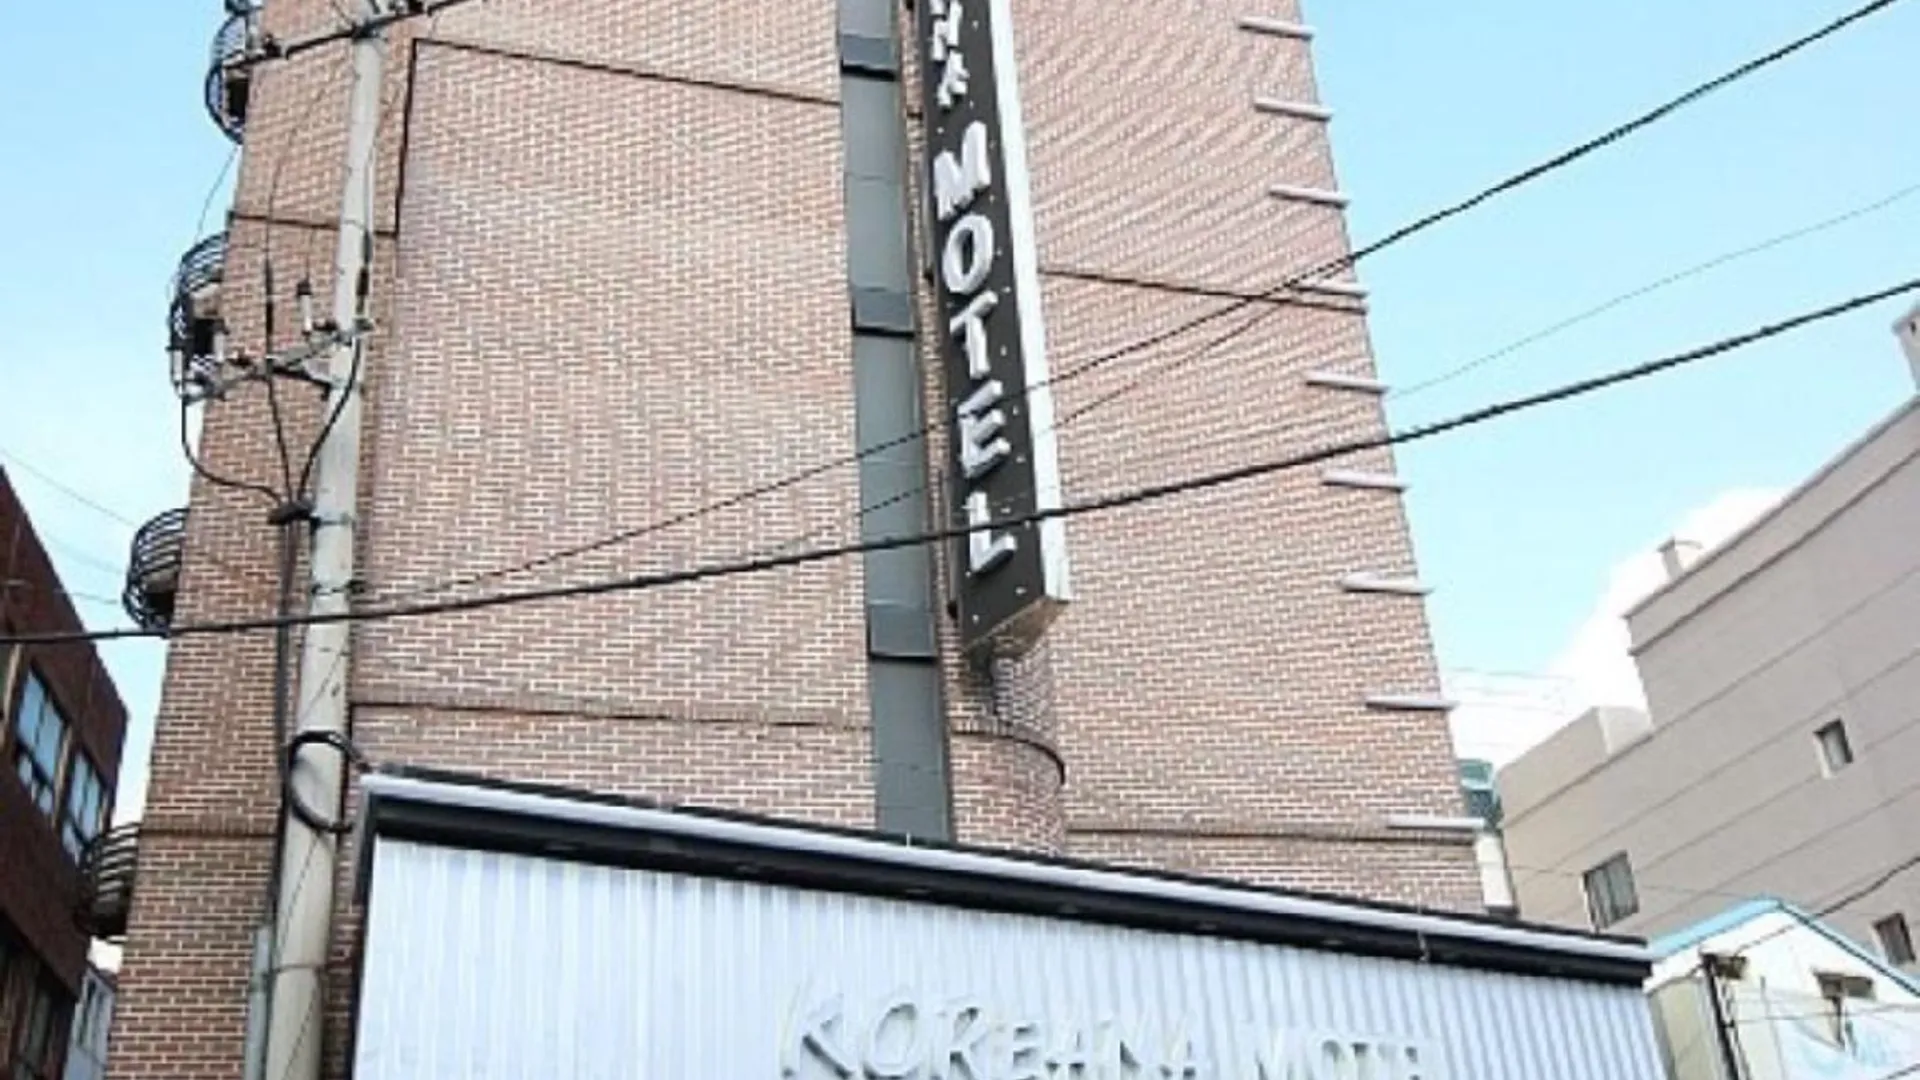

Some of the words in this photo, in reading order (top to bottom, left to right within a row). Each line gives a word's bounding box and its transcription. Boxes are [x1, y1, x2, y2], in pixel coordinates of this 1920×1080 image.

[929, 0, 970, 107] NA
[933, 120, 1017, 574] MOTEL
[778, 983, 1200, 1080] KOREANA
